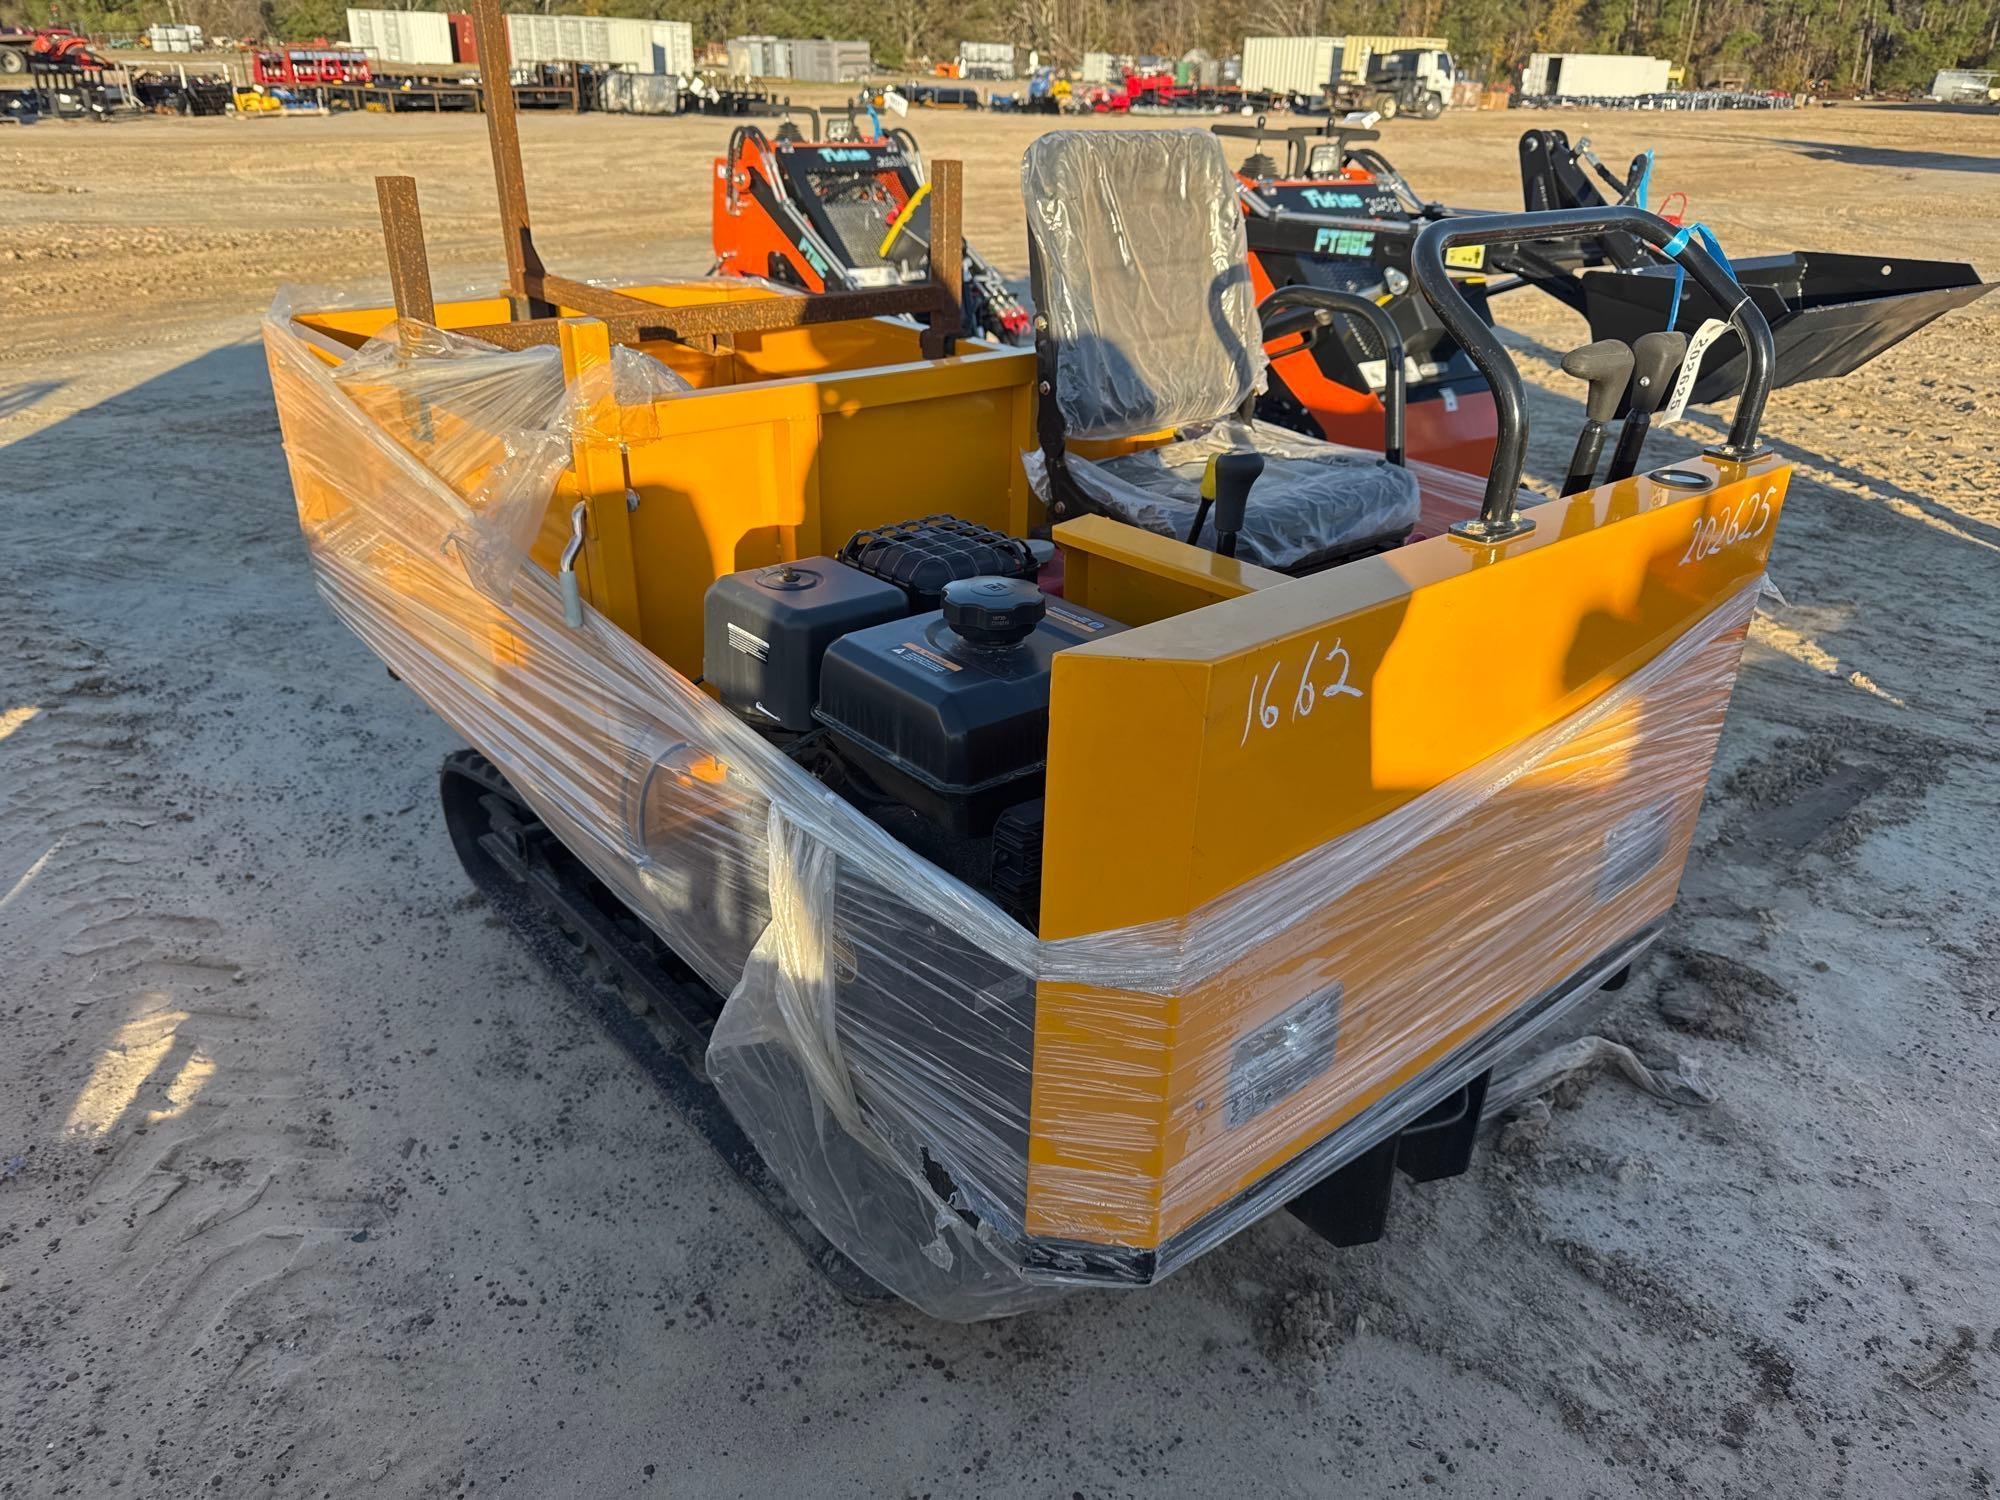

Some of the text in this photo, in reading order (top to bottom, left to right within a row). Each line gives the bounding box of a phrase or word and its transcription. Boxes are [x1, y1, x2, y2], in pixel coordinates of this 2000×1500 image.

[1670, 338, 1709, 411] 202625
[1678, 485, 1777, 567] 202625
[1240, 636, 1364, 748] 1662
